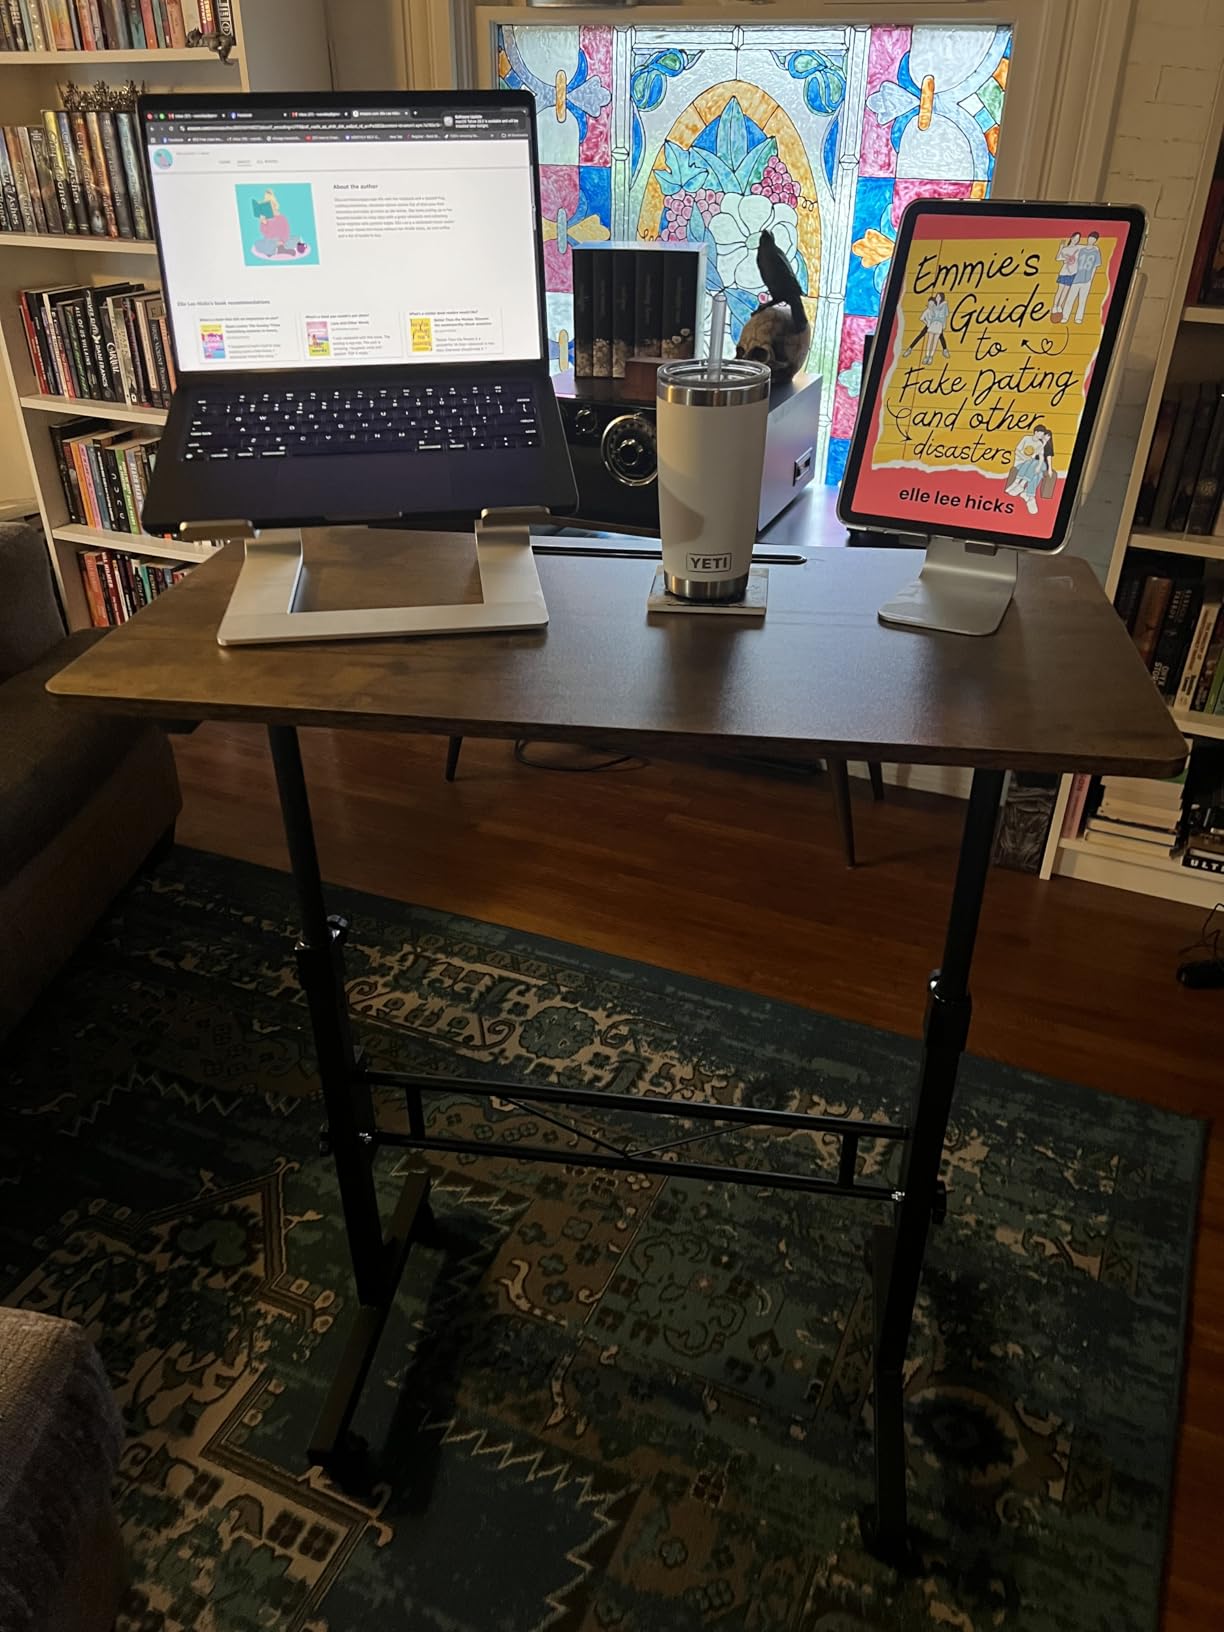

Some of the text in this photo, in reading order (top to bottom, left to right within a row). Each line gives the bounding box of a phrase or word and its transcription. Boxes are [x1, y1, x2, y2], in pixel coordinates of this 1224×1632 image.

[68, 170, 82, 205] Ashes
[914, 249, 1040, 294] Emmie's
[76, 318, 84, 329] OF
[950, 284, 1050, 344] Guide
[78, 329, 86, 339] US
[975, 327, 1007, 360] to
[80, 339, 92, 366] VILLAINS
[94, 343, 104, 361] DANI
[899, 356, 1078, 406] Fake Dating
[912, 397, 1044, 432] and other
[913, 430, 1011, 464] disasters
[899, 488, 1014, 514] elle lee hicks
[690, 557, 727, 569] YETI
[1149, 661, 1163, 685] STOR
[1157, 664, 1170, 687] ONYX
